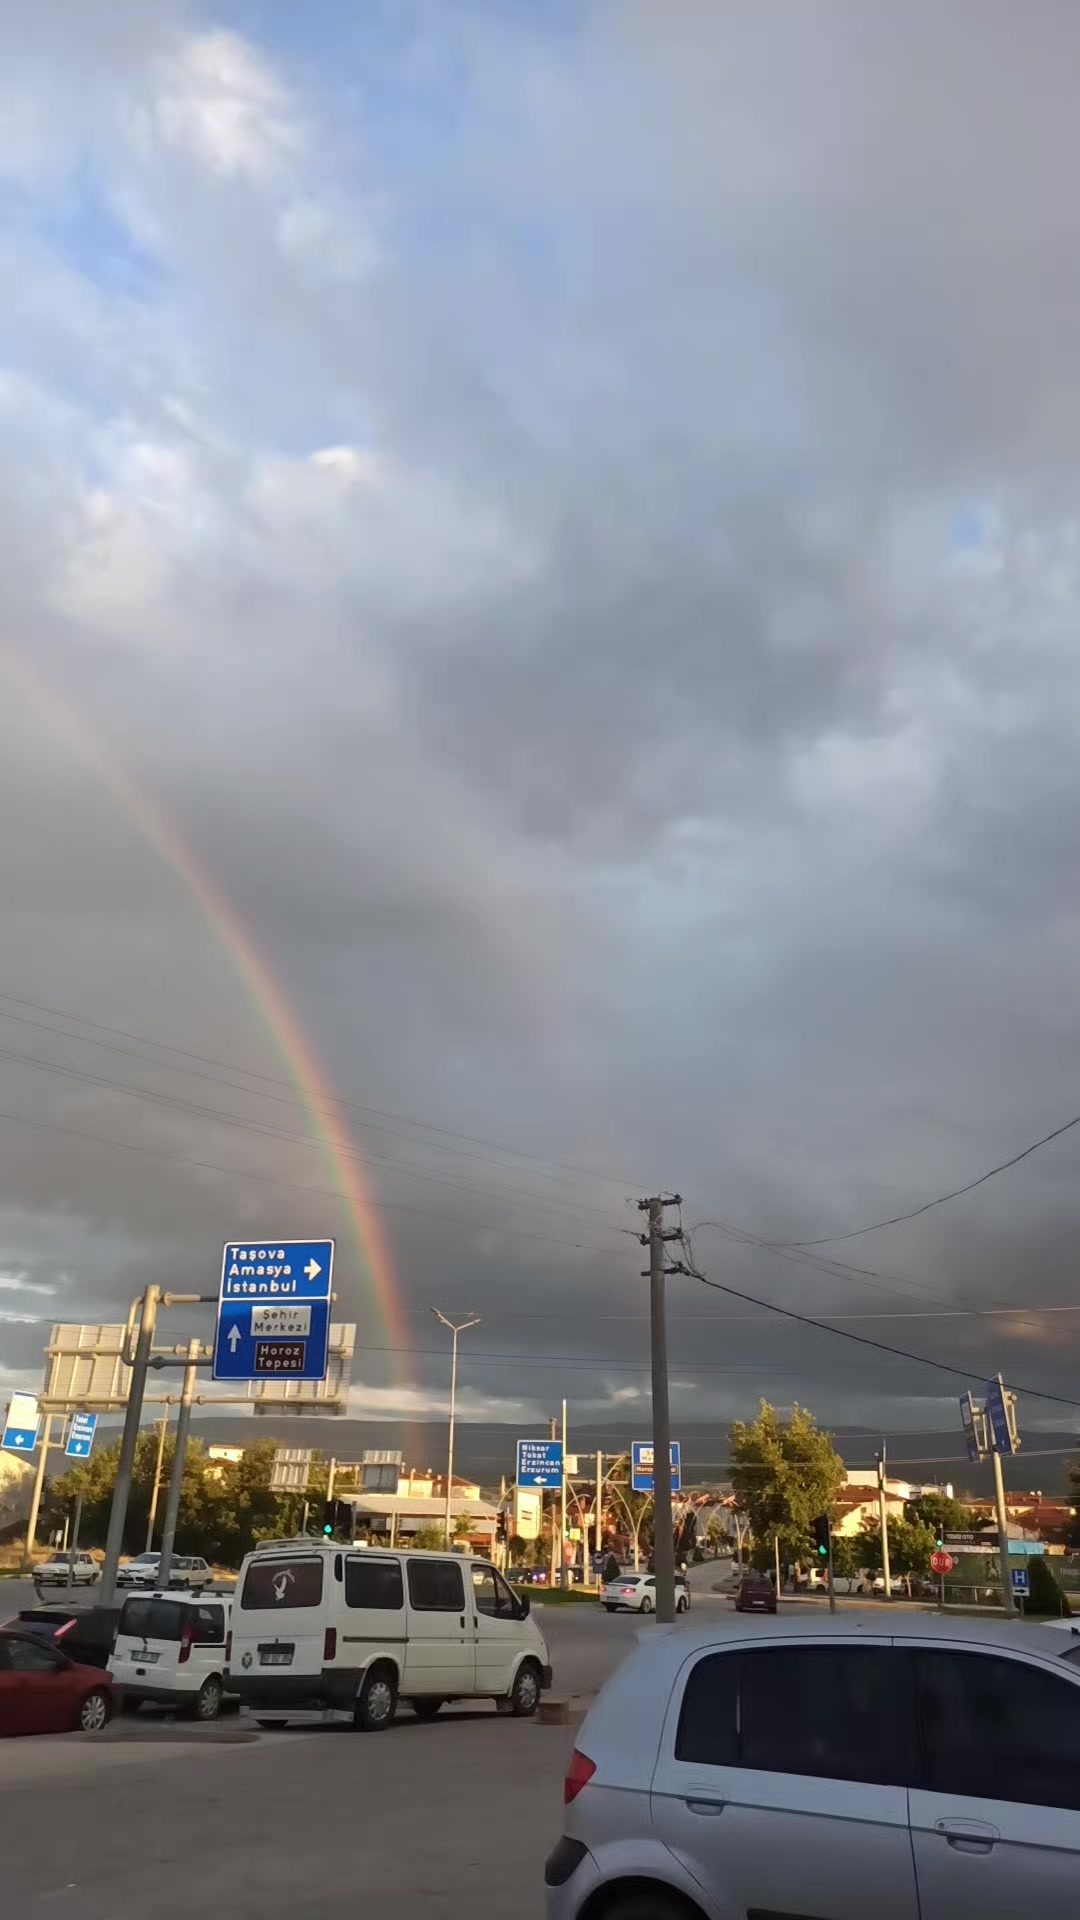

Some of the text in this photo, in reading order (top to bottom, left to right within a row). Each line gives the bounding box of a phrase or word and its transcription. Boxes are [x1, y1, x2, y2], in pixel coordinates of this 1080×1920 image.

[230, 1247, 286, 1261] Taşova
[229, 1263, 292, 1278] Amasya
[226, 1278, 297, 1293] İstanbul
[262, 1309, 299, 1320] Şehir
[254, 1322, 307, 1332] Merkezi
[260, 1345, 300, 1355] Horoz
[258, 1358, 302, 1370] Tepesi
[932, 1557, 950, 1567] DUR
[1014, 1570, 1025, 1584] H
